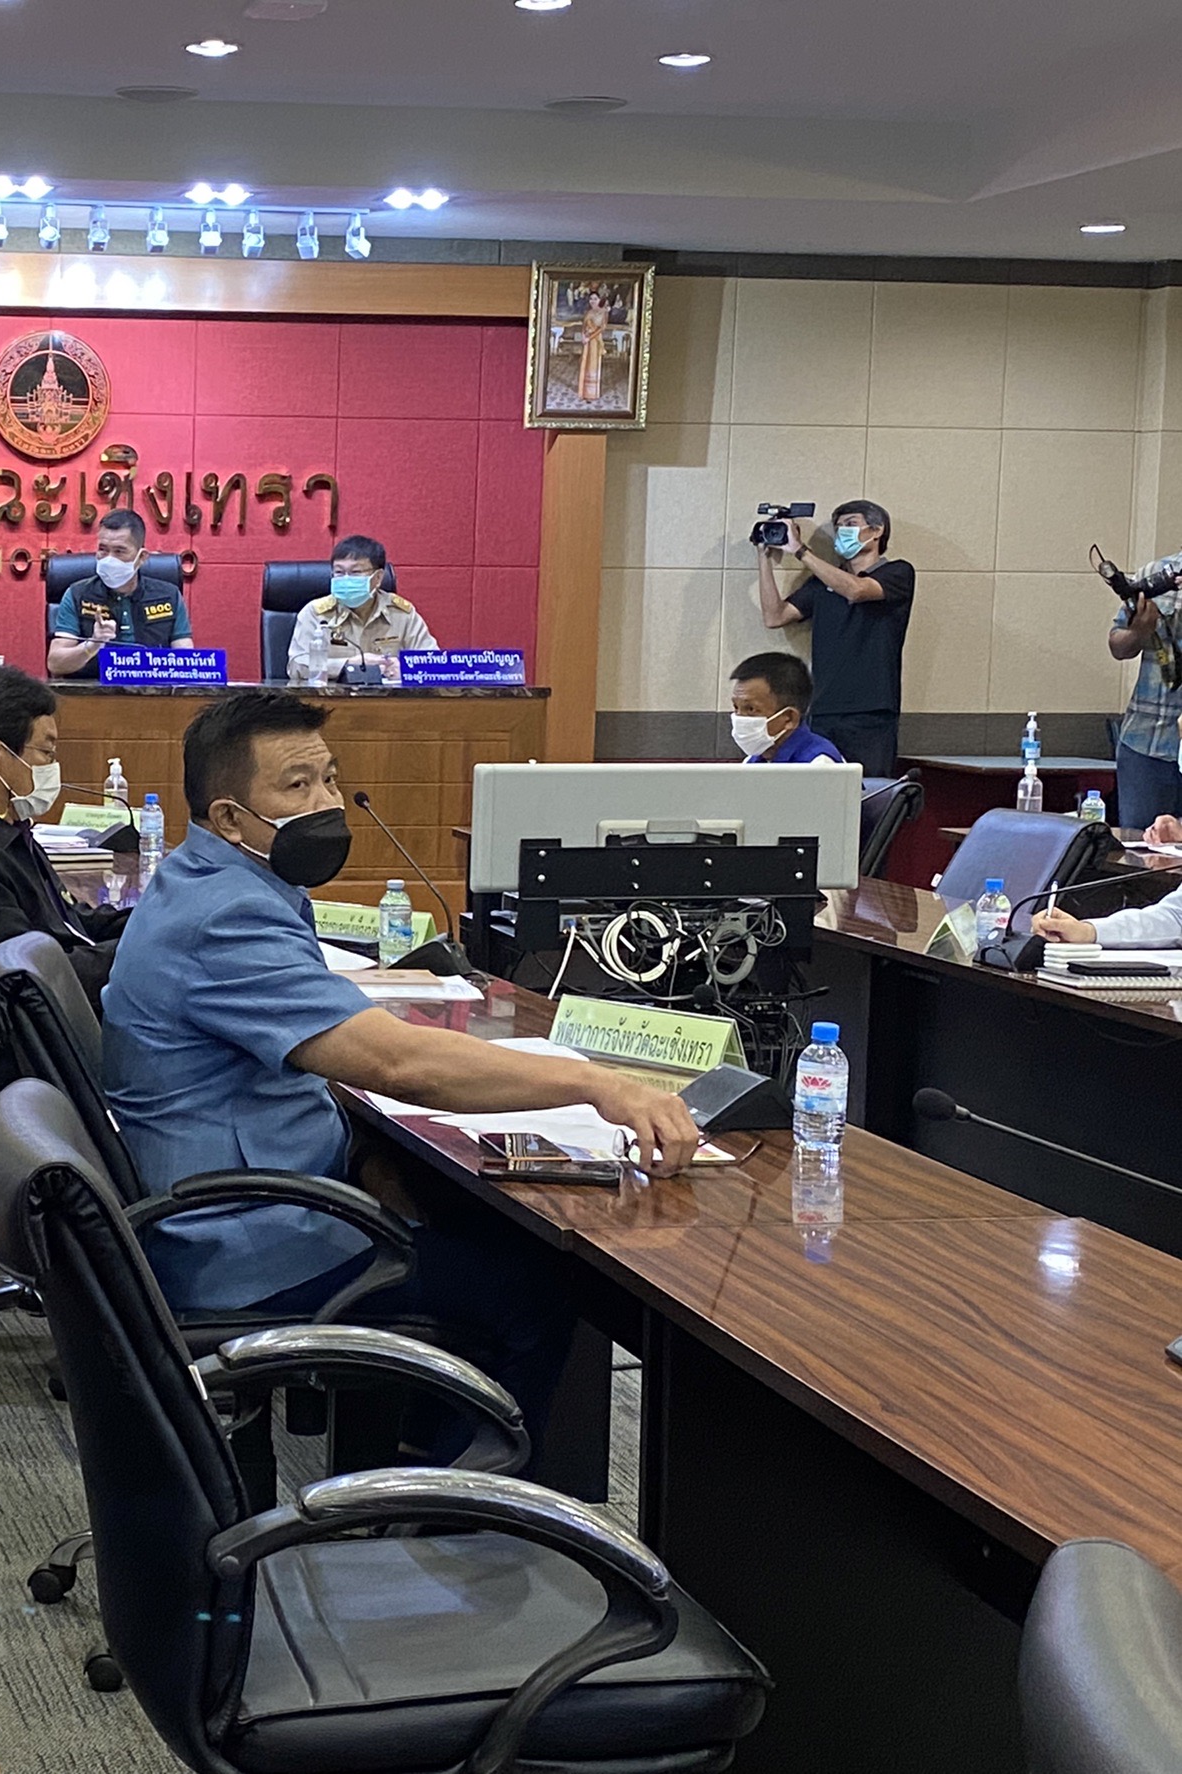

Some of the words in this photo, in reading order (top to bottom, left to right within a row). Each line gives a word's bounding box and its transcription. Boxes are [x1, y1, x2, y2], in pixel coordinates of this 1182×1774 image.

[110, 651, 141, 667] ไมตรี
[555, 1009, 714, 1067] พัฒนาการจังหวัดฉะเชิงเทรา
